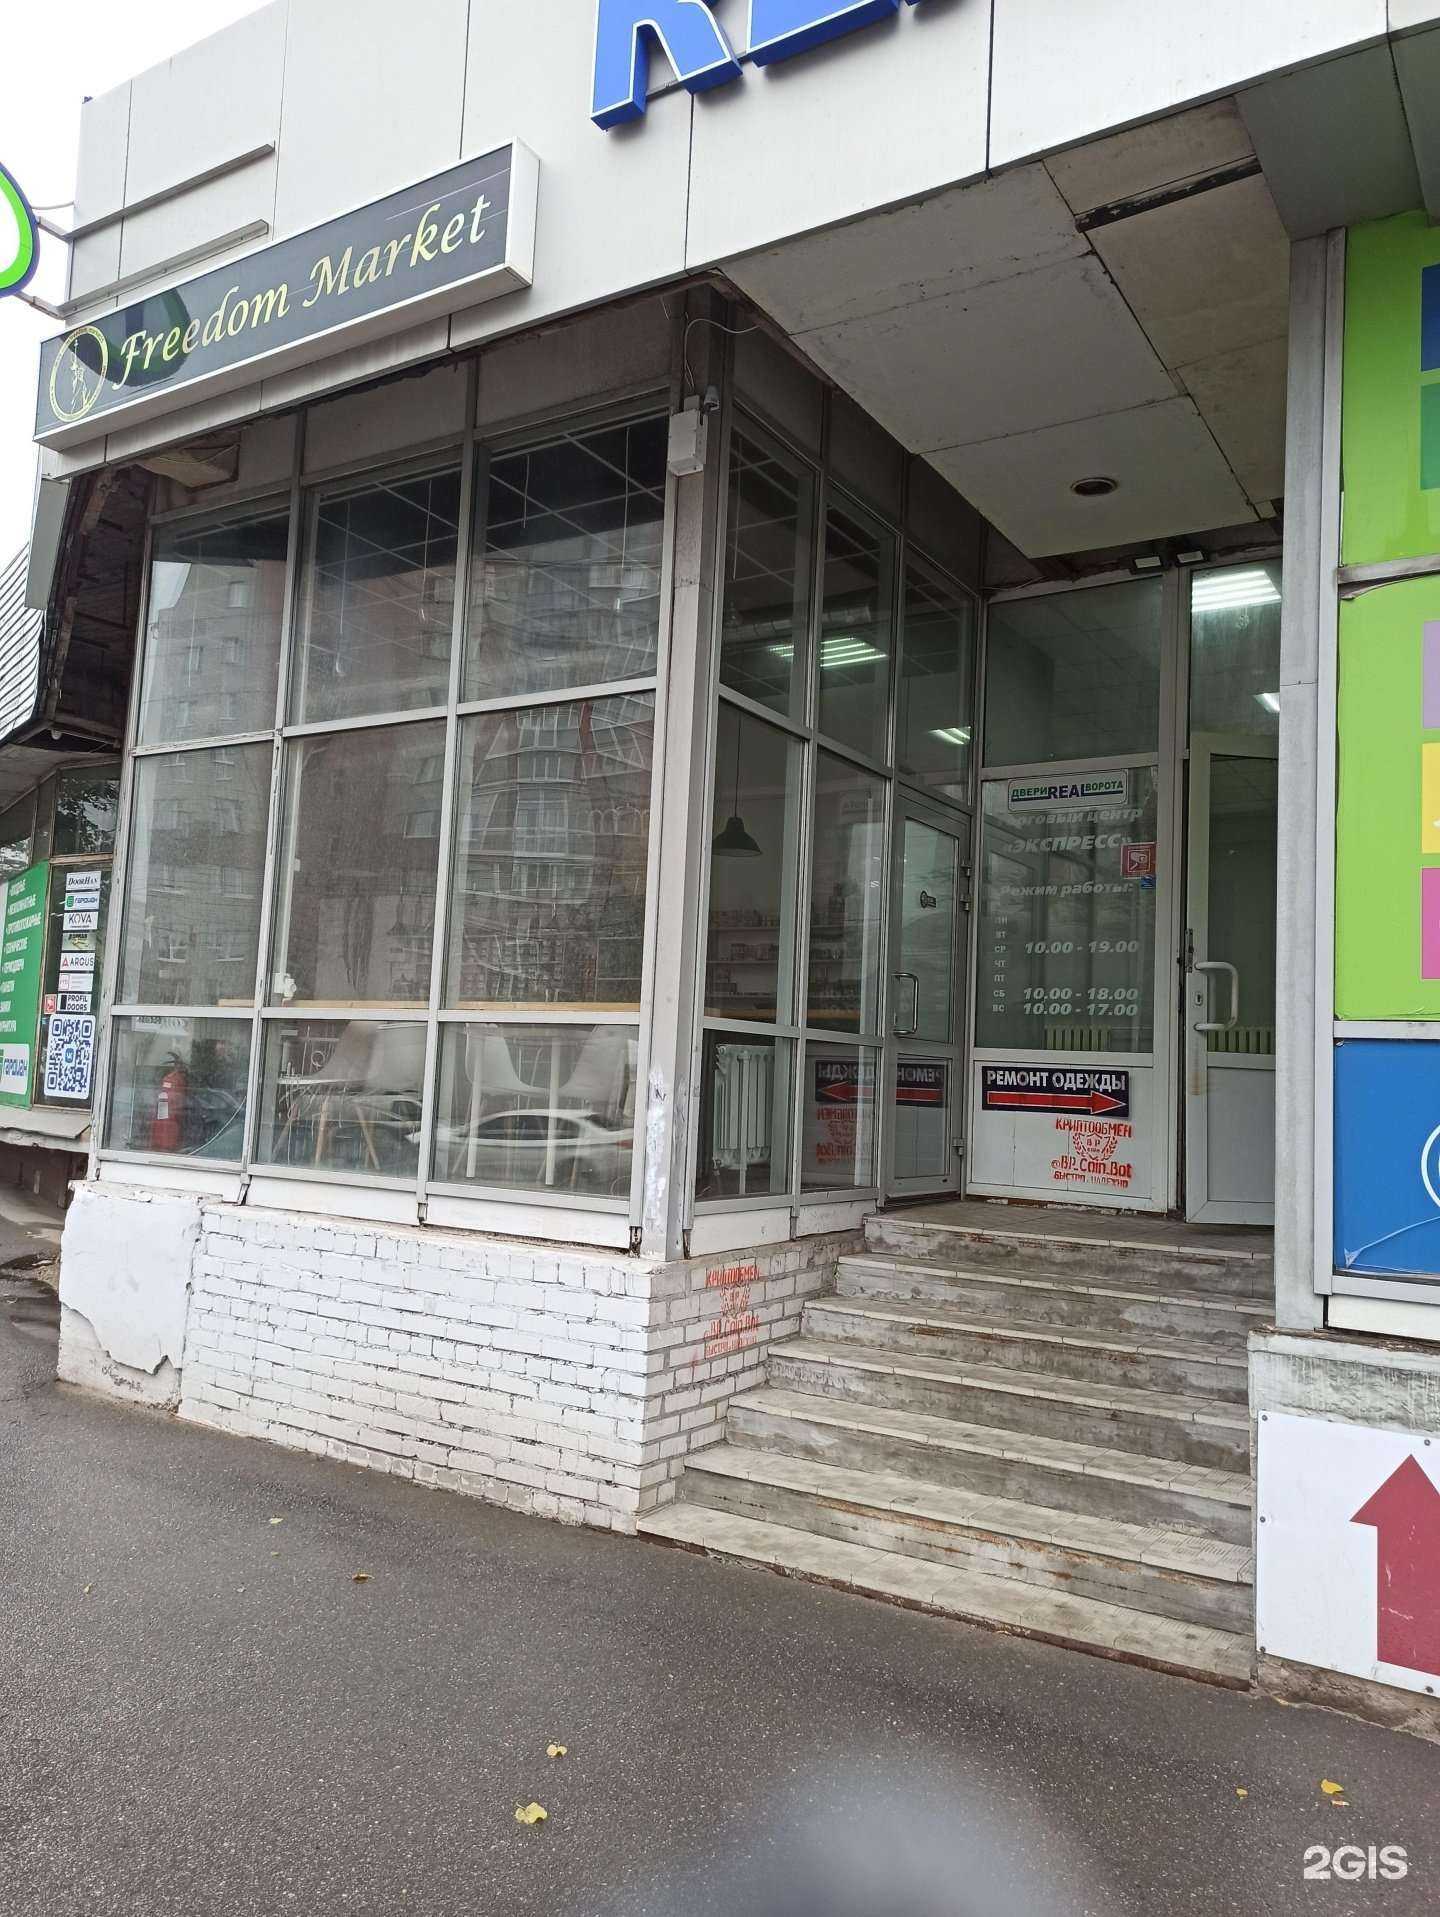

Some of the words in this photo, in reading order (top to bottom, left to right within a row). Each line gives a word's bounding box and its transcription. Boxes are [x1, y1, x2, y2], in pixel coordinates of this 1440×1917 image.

[112, 284, 290, 390] Freedom
[302, 194, 491, 308] Market
[1011, 787, 1048, 799] ДВЕРИ
[1048, 783, 1086, 800] REAL
[1086, 780, 1124, 792] ВОРОТА
[1001, 884, 1057, 897] Режим
[68, 913, 92, 924] KOVA
[1025, 941, 1074, 954] 10.00
[1088, 940, 1139, 953] 19.00
[70, 957, 95, 967] ARGUS
[67, 994, 88, 1003] PROFIL
[1024, 987, 1073, 1000] 10.00
[1087, 987, 1138, 1000] 18.00
[67, 1003, 88, 1011] DOORS
[1023, 1003, 1072, 1015] 10.00
[1086, 1003, 1138, 1016] 17.00
[987, 1070, 1048, 1087] РЕМОНТ
[1052, 1072, 1126, 1091] ОДЕЖДЫ
[1056, 1117, 1132, 1138] КРИПТООБМЕН
